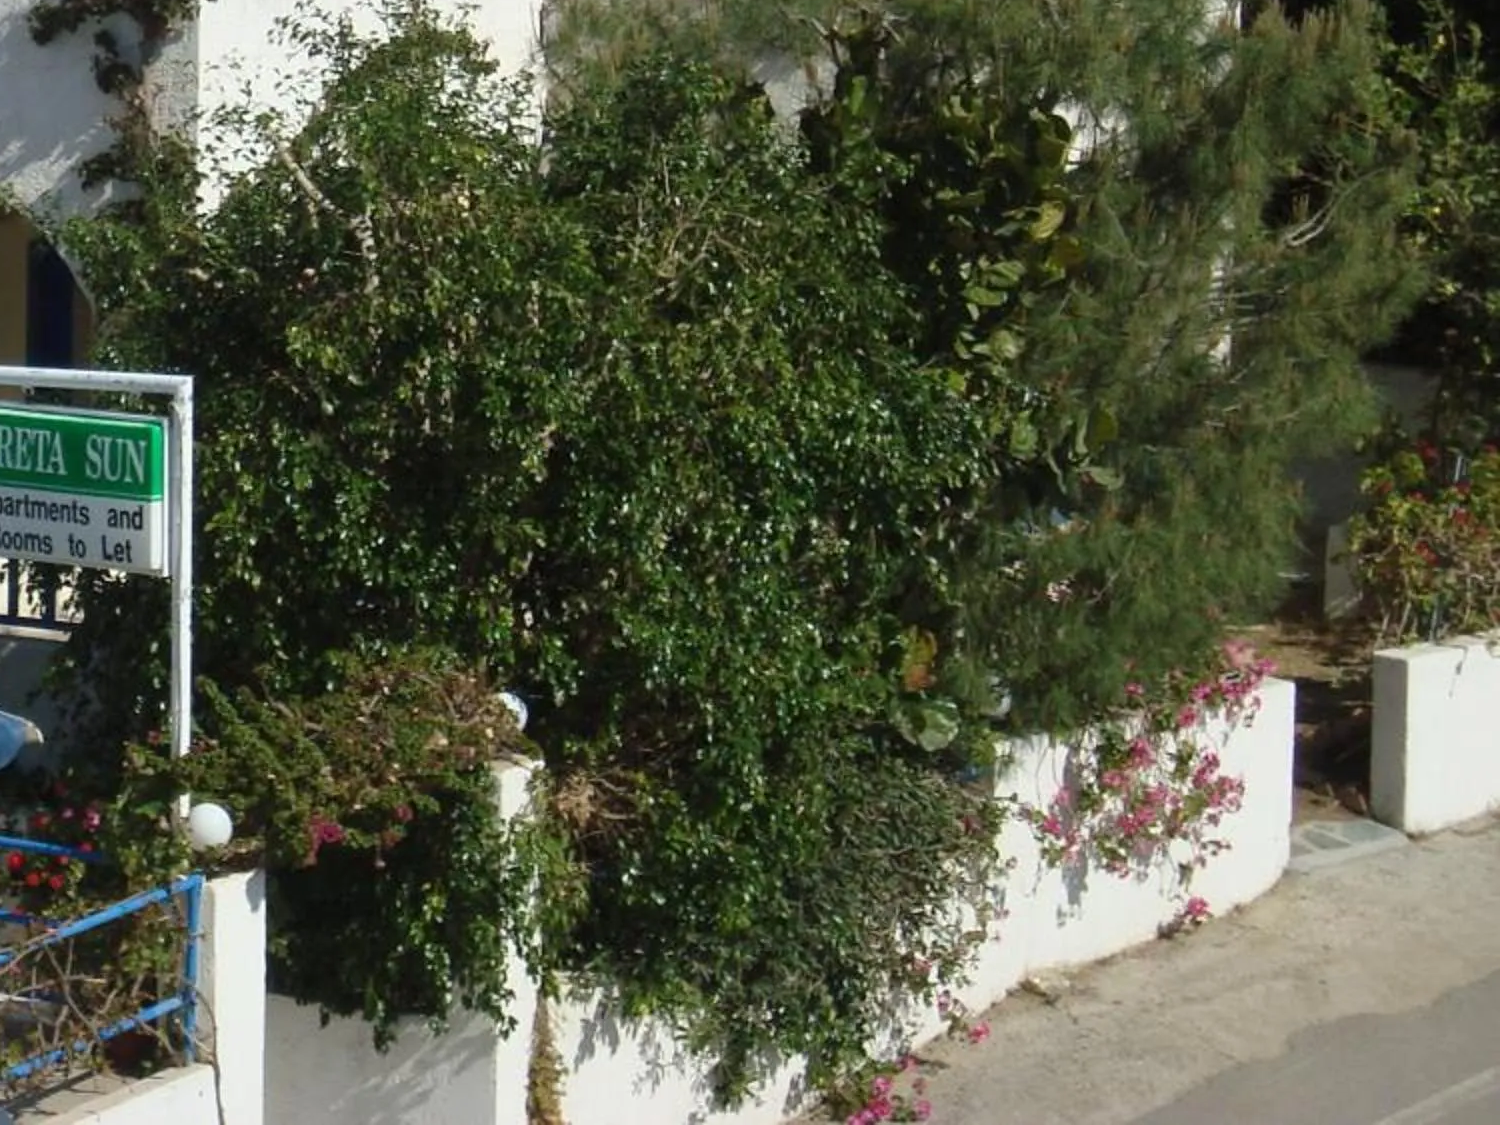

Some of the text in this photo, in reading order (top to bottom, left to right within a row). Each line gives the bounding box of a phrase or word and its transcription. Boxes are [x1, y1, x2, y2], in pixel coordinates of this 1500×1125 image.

[85, 434, 148, 485] SUN
[107, 505, 144, 531] and
[68, 533, 86, 559] to
[102, 534, 132, 563] Let
